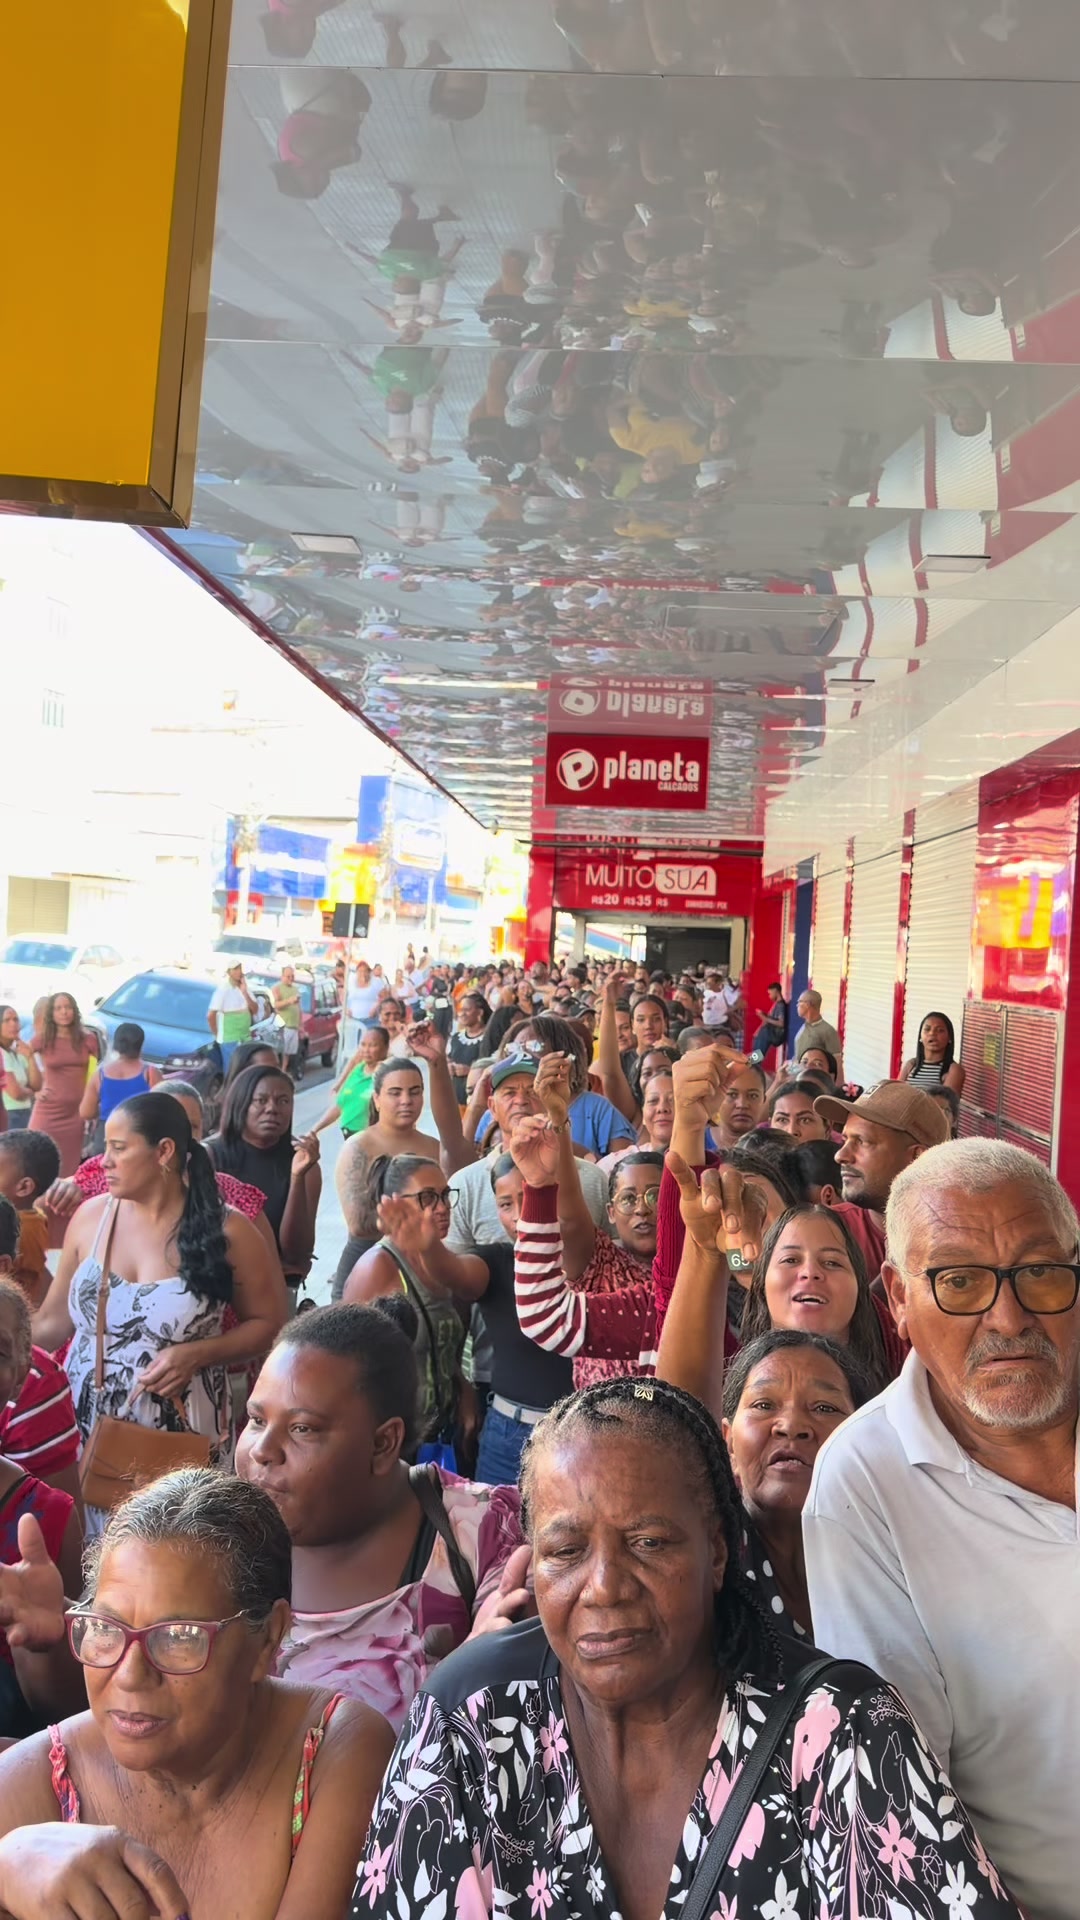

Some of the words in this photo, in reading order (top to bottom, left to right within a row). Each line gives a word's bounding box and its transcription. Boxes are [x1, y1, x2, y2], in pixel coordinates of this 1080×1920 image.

[603, 750, 700, 789] planeta
[657, 781, 699, 792] CALÇADOS
[585, 863, 655, 889] MUITO
[664, 868, 709, 891] SUA
